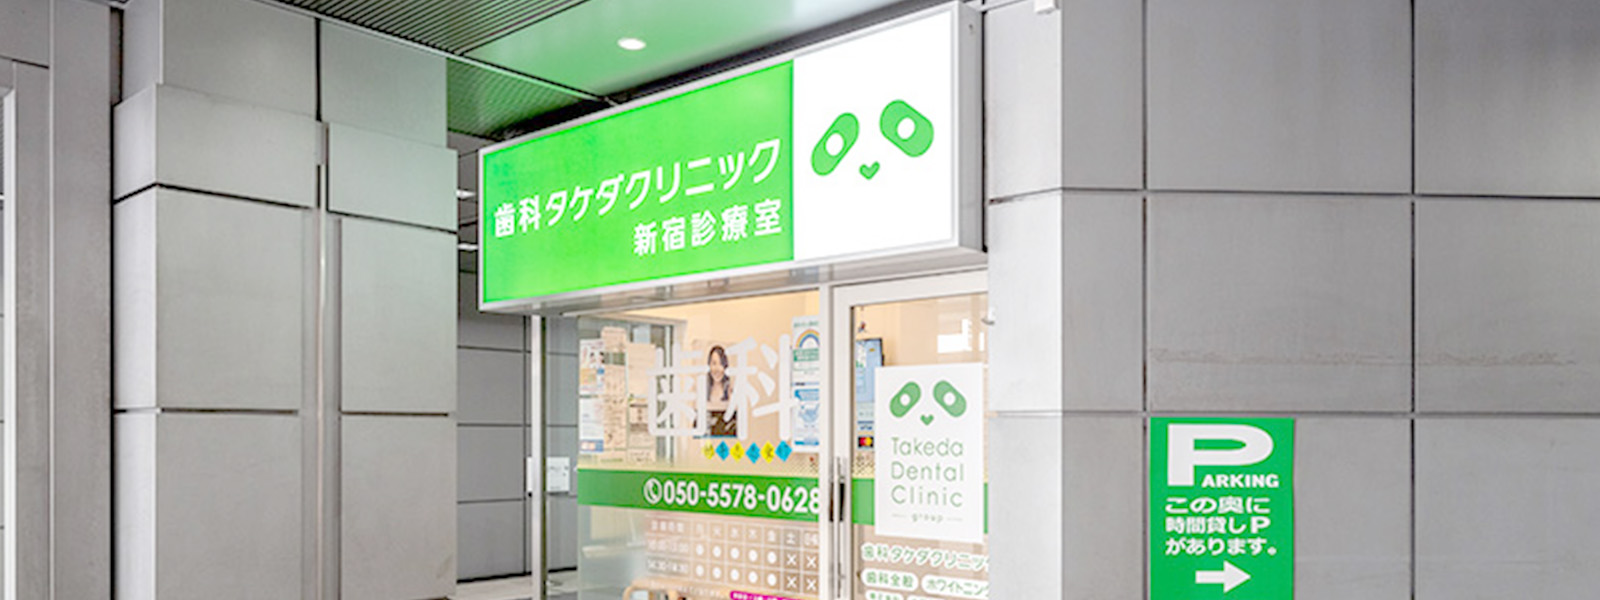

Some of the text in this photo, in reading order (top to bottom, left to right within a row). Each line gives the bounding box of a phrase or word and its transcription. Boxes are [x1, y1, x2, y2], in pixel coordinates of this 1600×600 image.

[494, 138, 781, 238] 歯科タケダクリニック
[633, 198, 782, 256] 新宿診療室
[647, 333, 801, 441] 歯科
[891, 437, 964, 457] Takeda
[891, 461, 964, 482] Dental
[663, 479, 820, 514] 050-5578-0628
[891, 484, 963, 508] Clinic
[1165, 496, 1271, 514] この奥に
[1165, 537, 1277, 555] があります。
